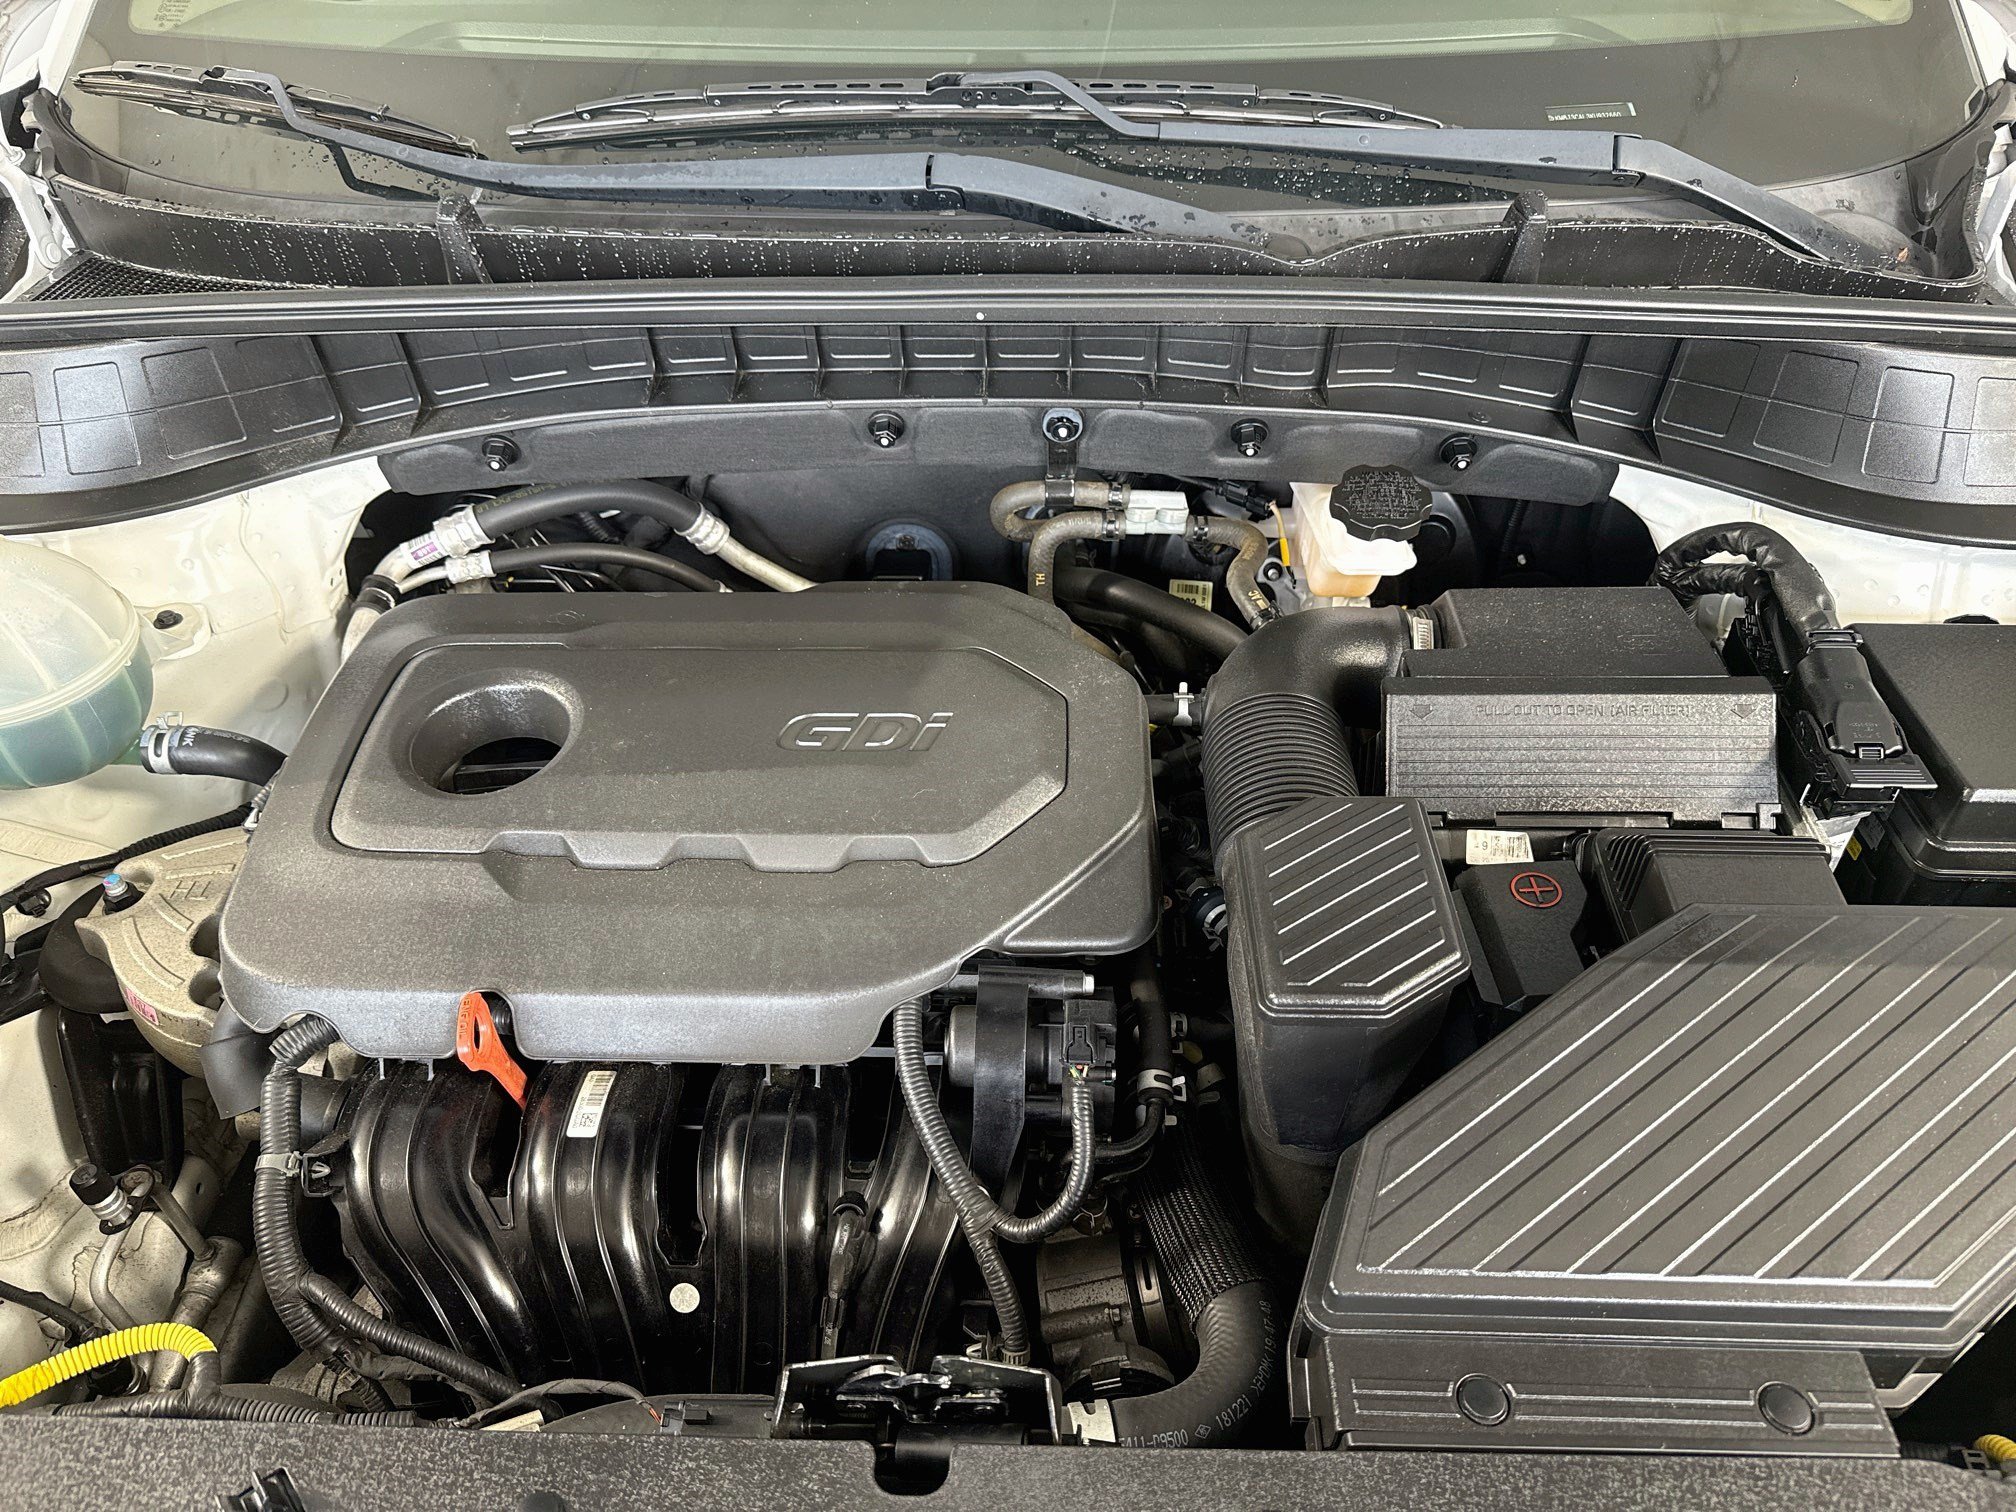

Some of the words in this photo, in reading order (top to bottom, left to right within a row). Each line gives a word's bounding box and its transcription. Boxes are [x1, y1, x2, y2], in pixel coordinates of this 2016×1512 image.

[1035, 572, 1046, 586] TH
[1475, 704, 1510, 717] PULL
[1513, 704, 1542, 716] OUT
[1546, 704, 1562, 716] TO
[1567, 704, 1604, 716] OPEN
[776, 712, 954, 751] GDi
[460, 998, 471, 1019] ENG
[459, 1021, 469, 1040] OIL
[1215, 1394, 1253, 1431] 181221
